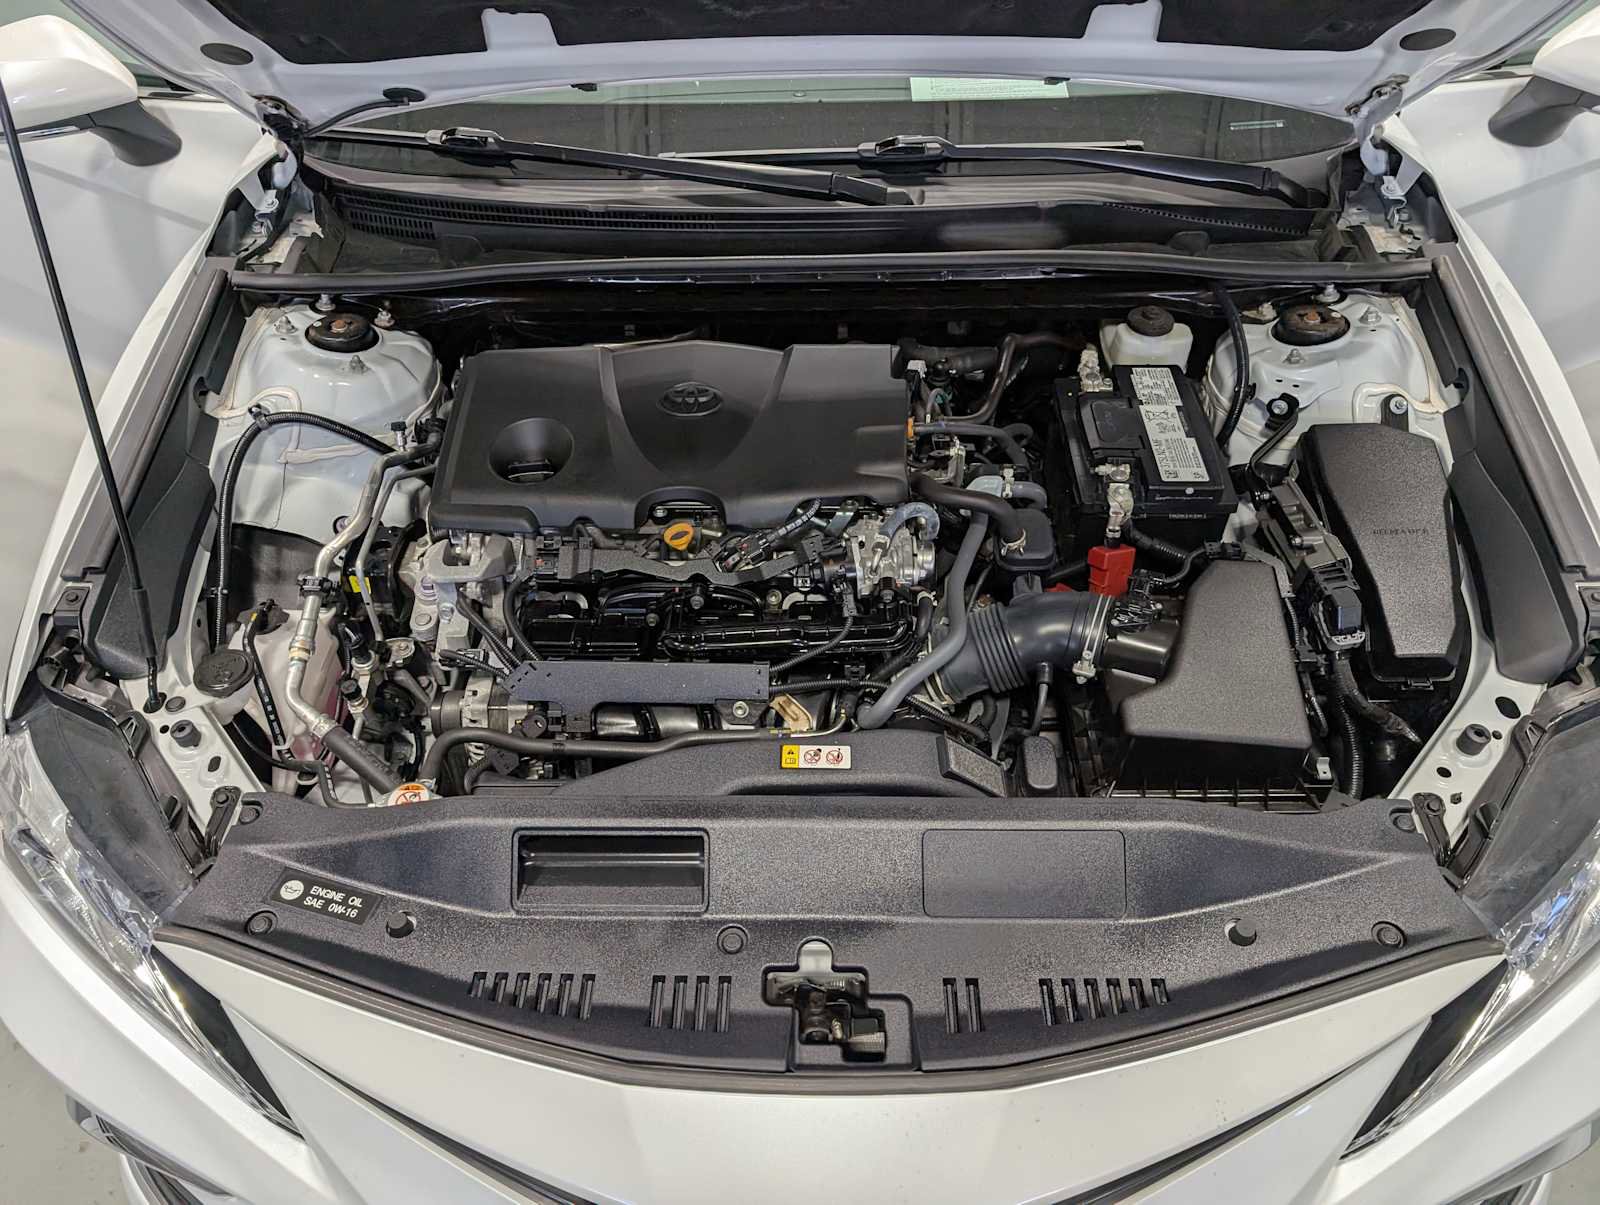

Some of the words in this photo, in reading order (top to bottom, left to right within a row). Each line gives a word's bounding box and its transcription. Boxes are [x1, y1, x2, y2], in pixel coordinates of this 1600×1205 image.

[303, 896, 325, 909] SAE
[328, 903, 358, 918] 0W-16
[310, 886, 345, 902] ENGINE
[348, 896, 363, 908] OIL
